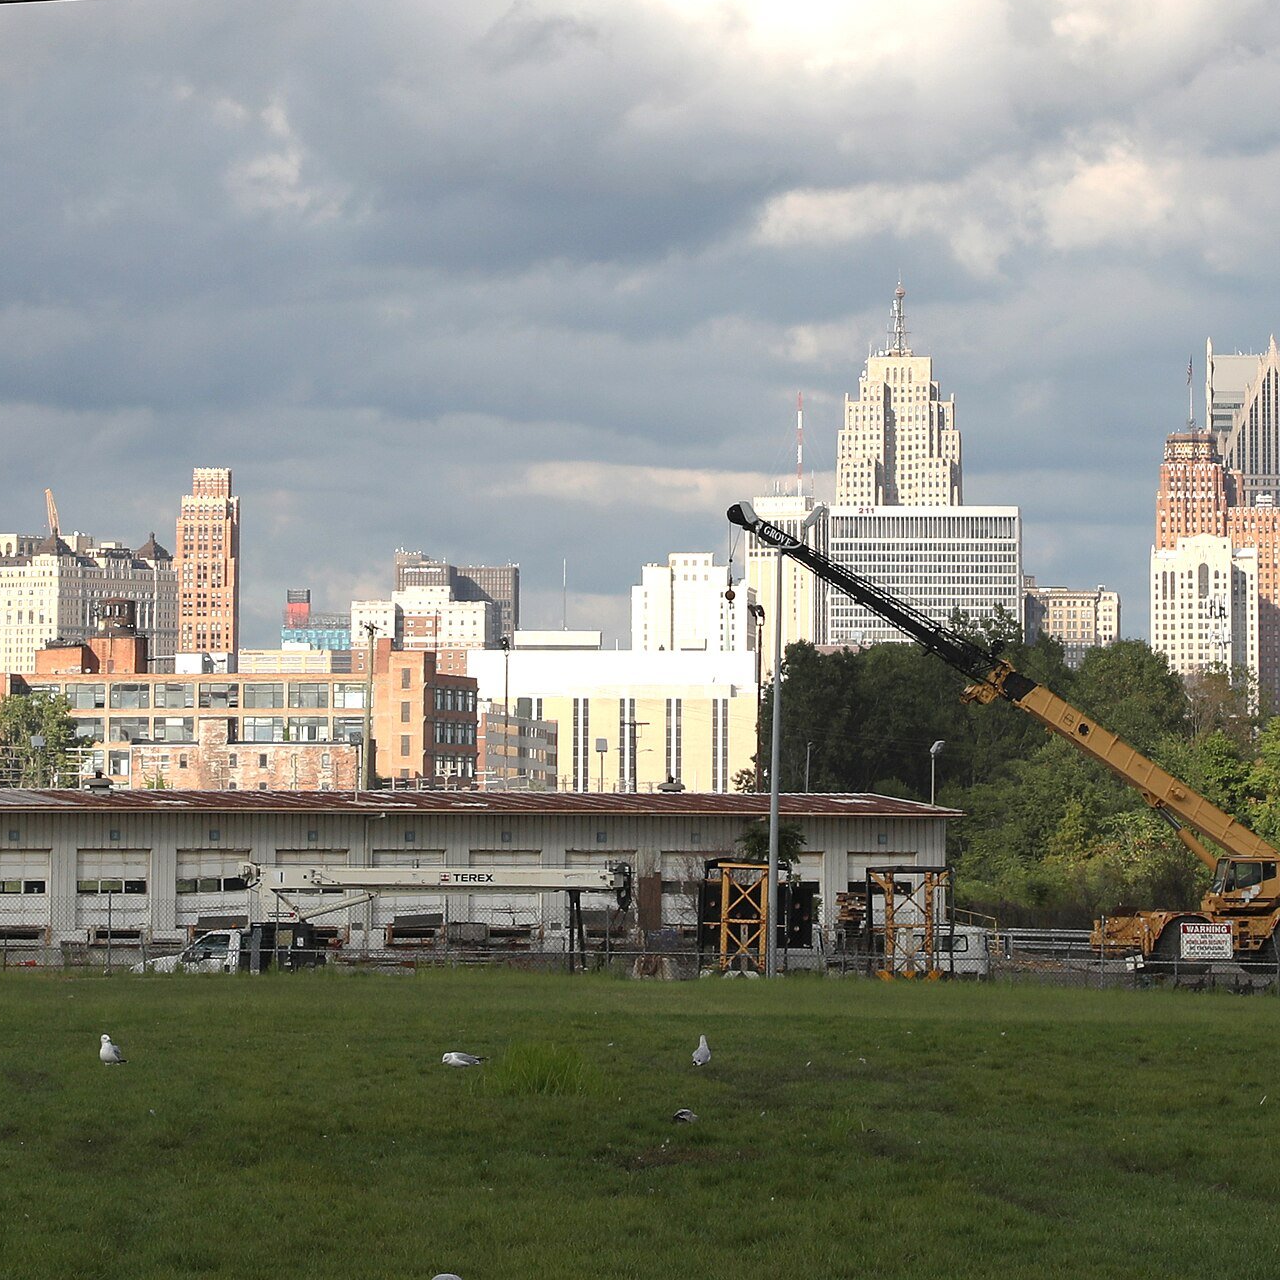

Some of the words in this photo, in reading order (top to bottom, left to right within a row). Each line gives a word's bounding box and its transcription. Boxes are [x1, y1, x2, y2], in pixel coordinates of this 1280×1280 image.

[763, 526, 793, 547] GROVE
[453, 873, 494, 882] TEREX
[1186, 925, 1228, 933] WARNING
